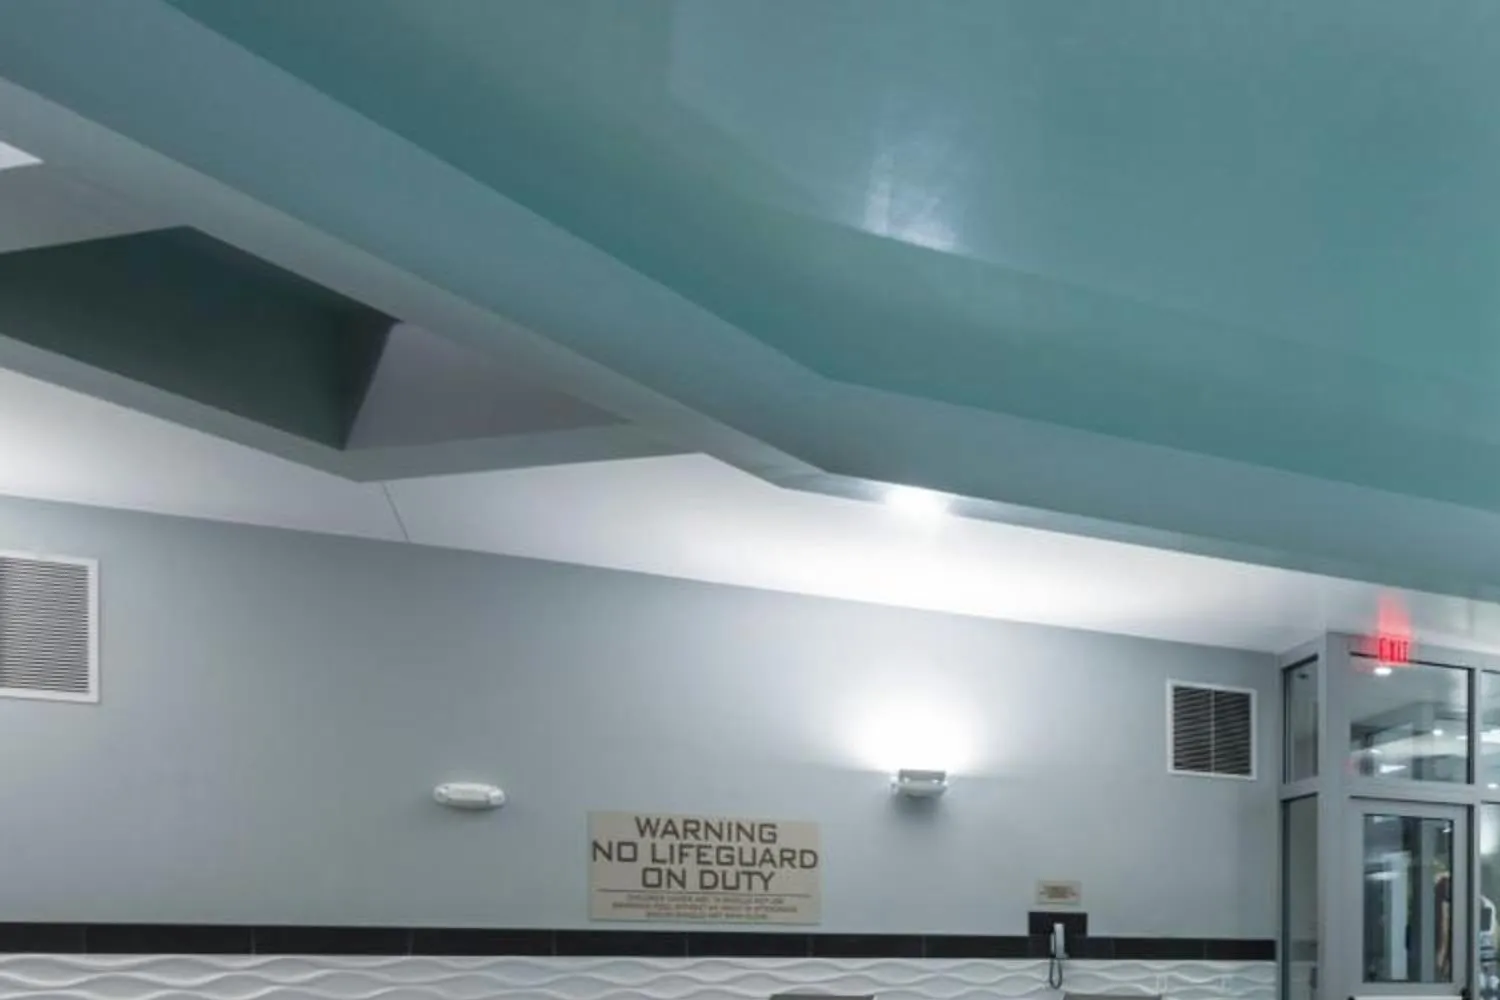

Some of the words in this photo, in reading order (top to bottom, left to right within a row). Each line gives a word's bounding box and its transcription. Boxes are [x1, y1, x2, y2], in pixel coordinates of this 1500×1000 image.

[1379, 637, 1408, 663] EXIT
[635, 816, 778, 844] WARNING
[592, 840, 638, 863] NO
[652, 843, 818, 869] LIFEGUARD
[642, 867, 687, 889] ON
[699, 869, 775, 891] DUTY
